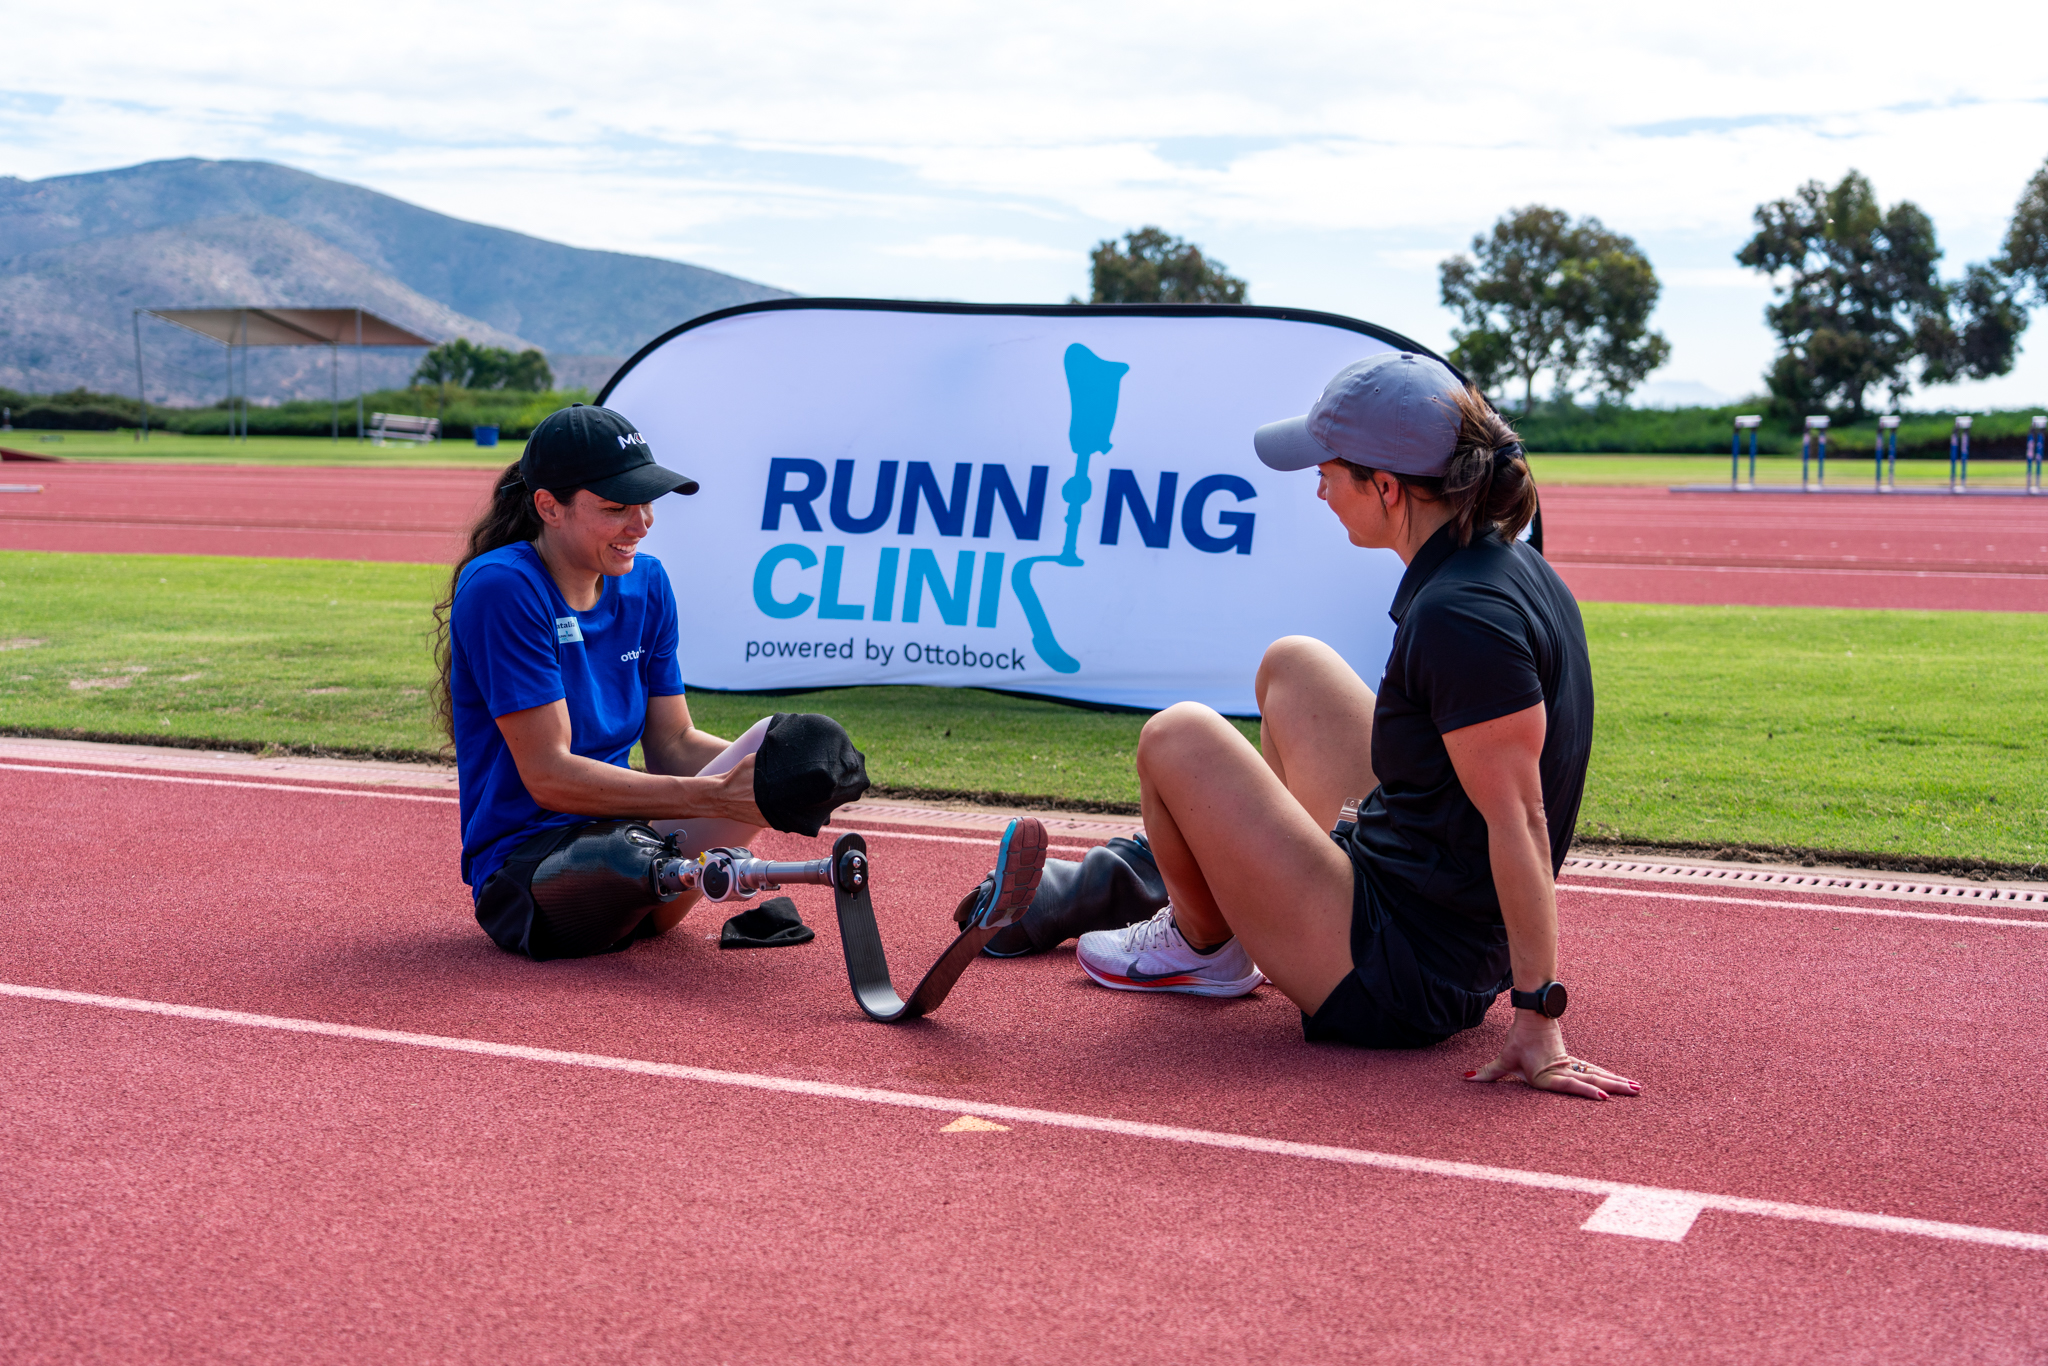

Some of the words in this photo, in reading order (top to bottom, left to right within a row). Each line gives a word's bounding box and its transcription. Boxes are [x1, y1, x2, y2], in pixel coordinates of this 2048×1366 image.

[745, 637, 854, 663] powered
[865, 637, 894, 666] by
[903, 641, 1026, 671] Ottobock
